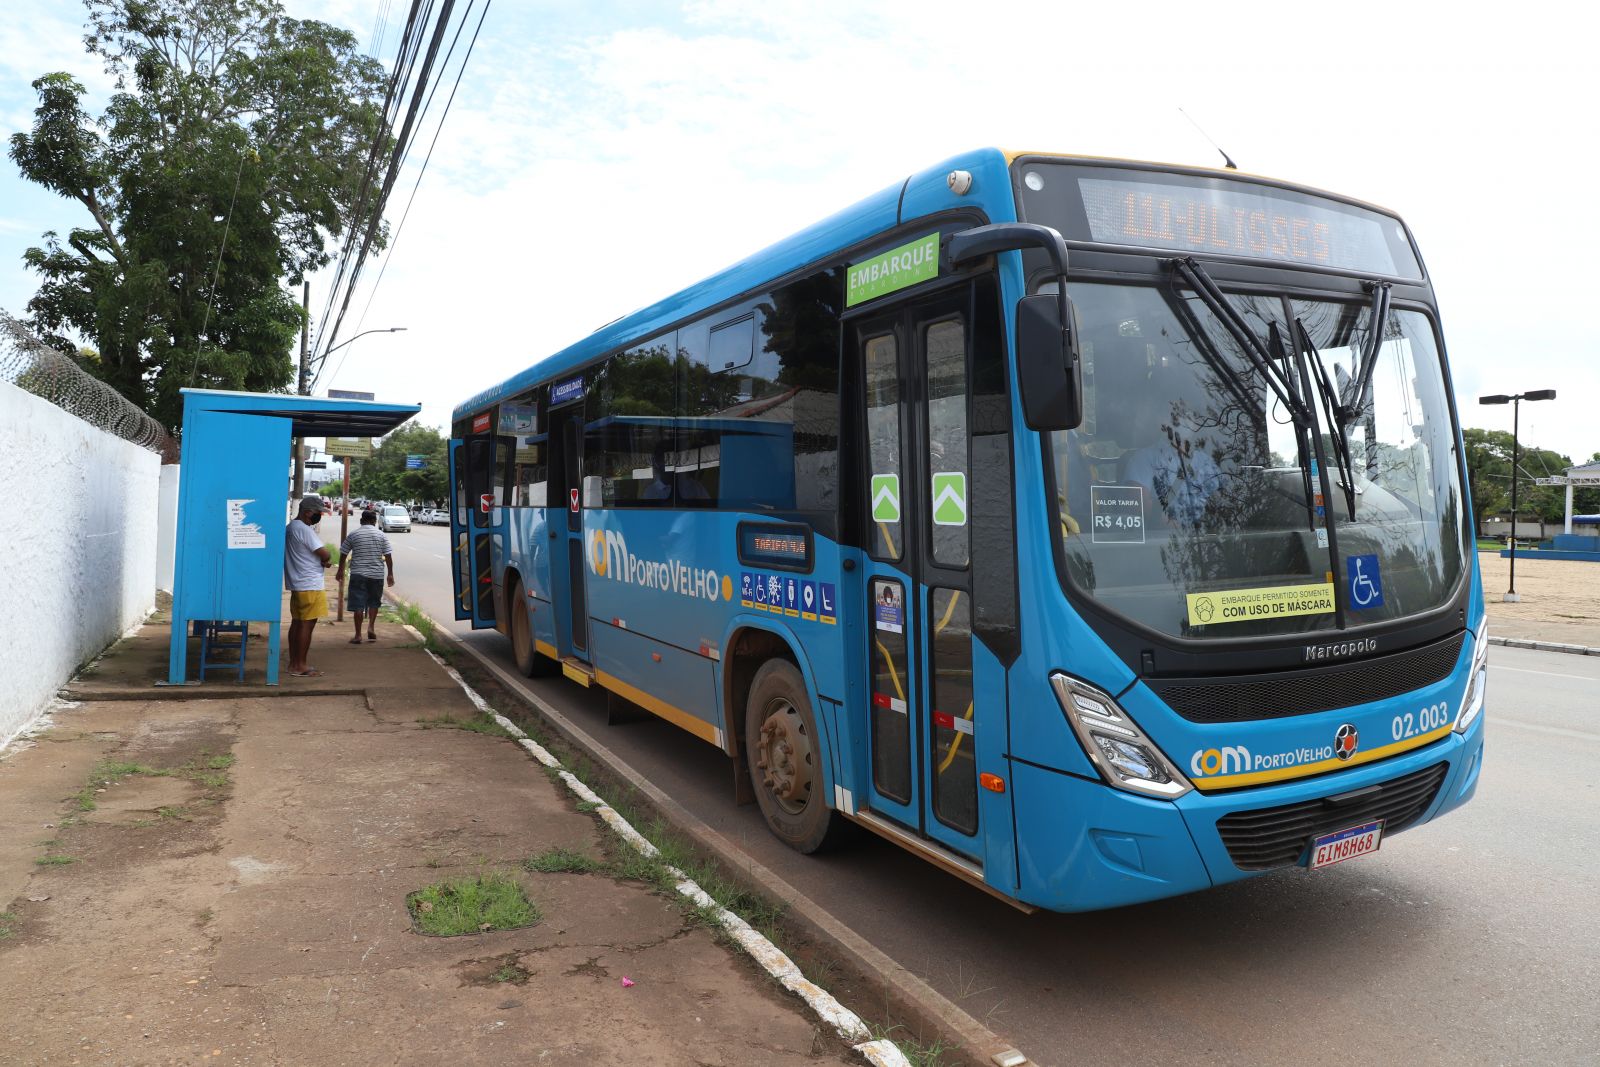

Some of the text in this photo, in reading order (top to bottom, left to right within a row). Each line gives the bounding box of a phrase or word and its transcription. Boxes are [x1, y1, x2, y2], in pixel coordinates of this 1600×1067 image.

[850, 242, 934, 290] EMBARQUE
[850, 262, 933, 300] BOARDING
[1118, 499, 1139, 507] TARIFA
[1095, 515, 1142, 530] R$ 4,05
[754, 538, 788, 552] TARIFA
[1221, 588, 1330, 605] EMBARQUE PERMITIDO SOMENTE
[1222, 599, 1332, 618] COM USO DE MÁSCARA
[1305, 638, 1377, 661] Marcopolo
[1391, 701, 1448, 741] 02.003
[1316, 833, 1374, 865] GIM8H68
